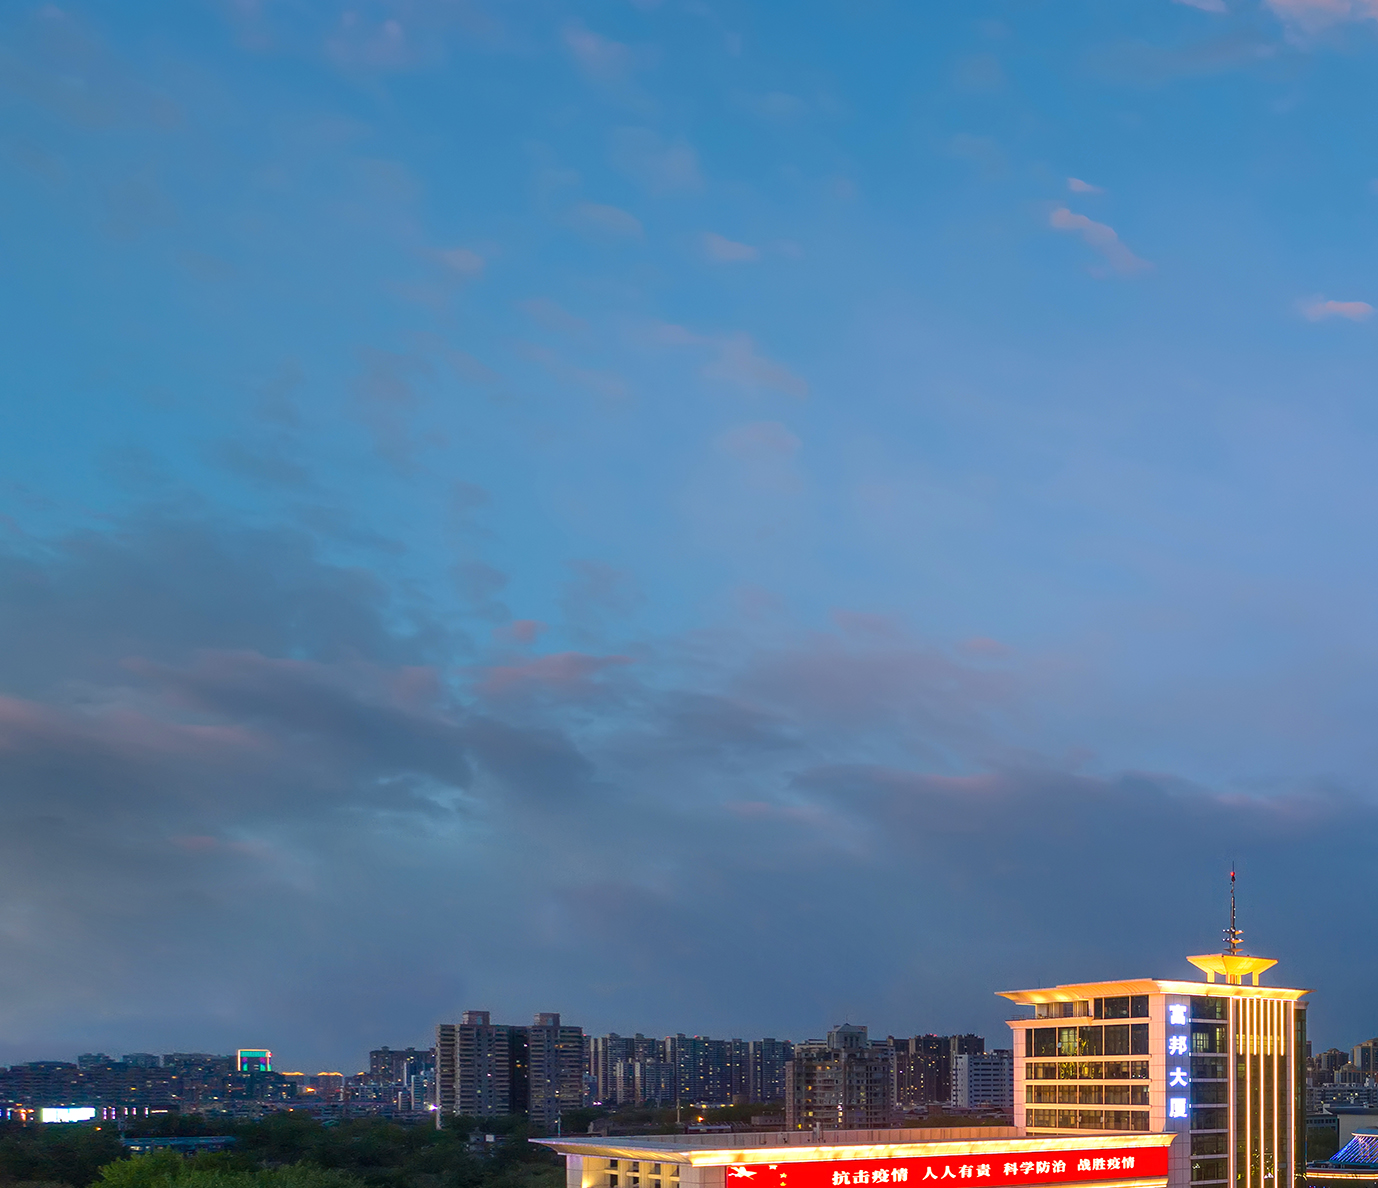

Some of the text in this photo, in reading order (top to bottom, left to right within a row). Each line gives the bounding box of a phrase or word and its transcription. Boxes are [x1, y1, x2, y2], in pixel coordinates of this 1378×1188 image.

[831, 1156, 1136, 1186] 抗击疫情 人人有责 科学防治 战胜疫情
